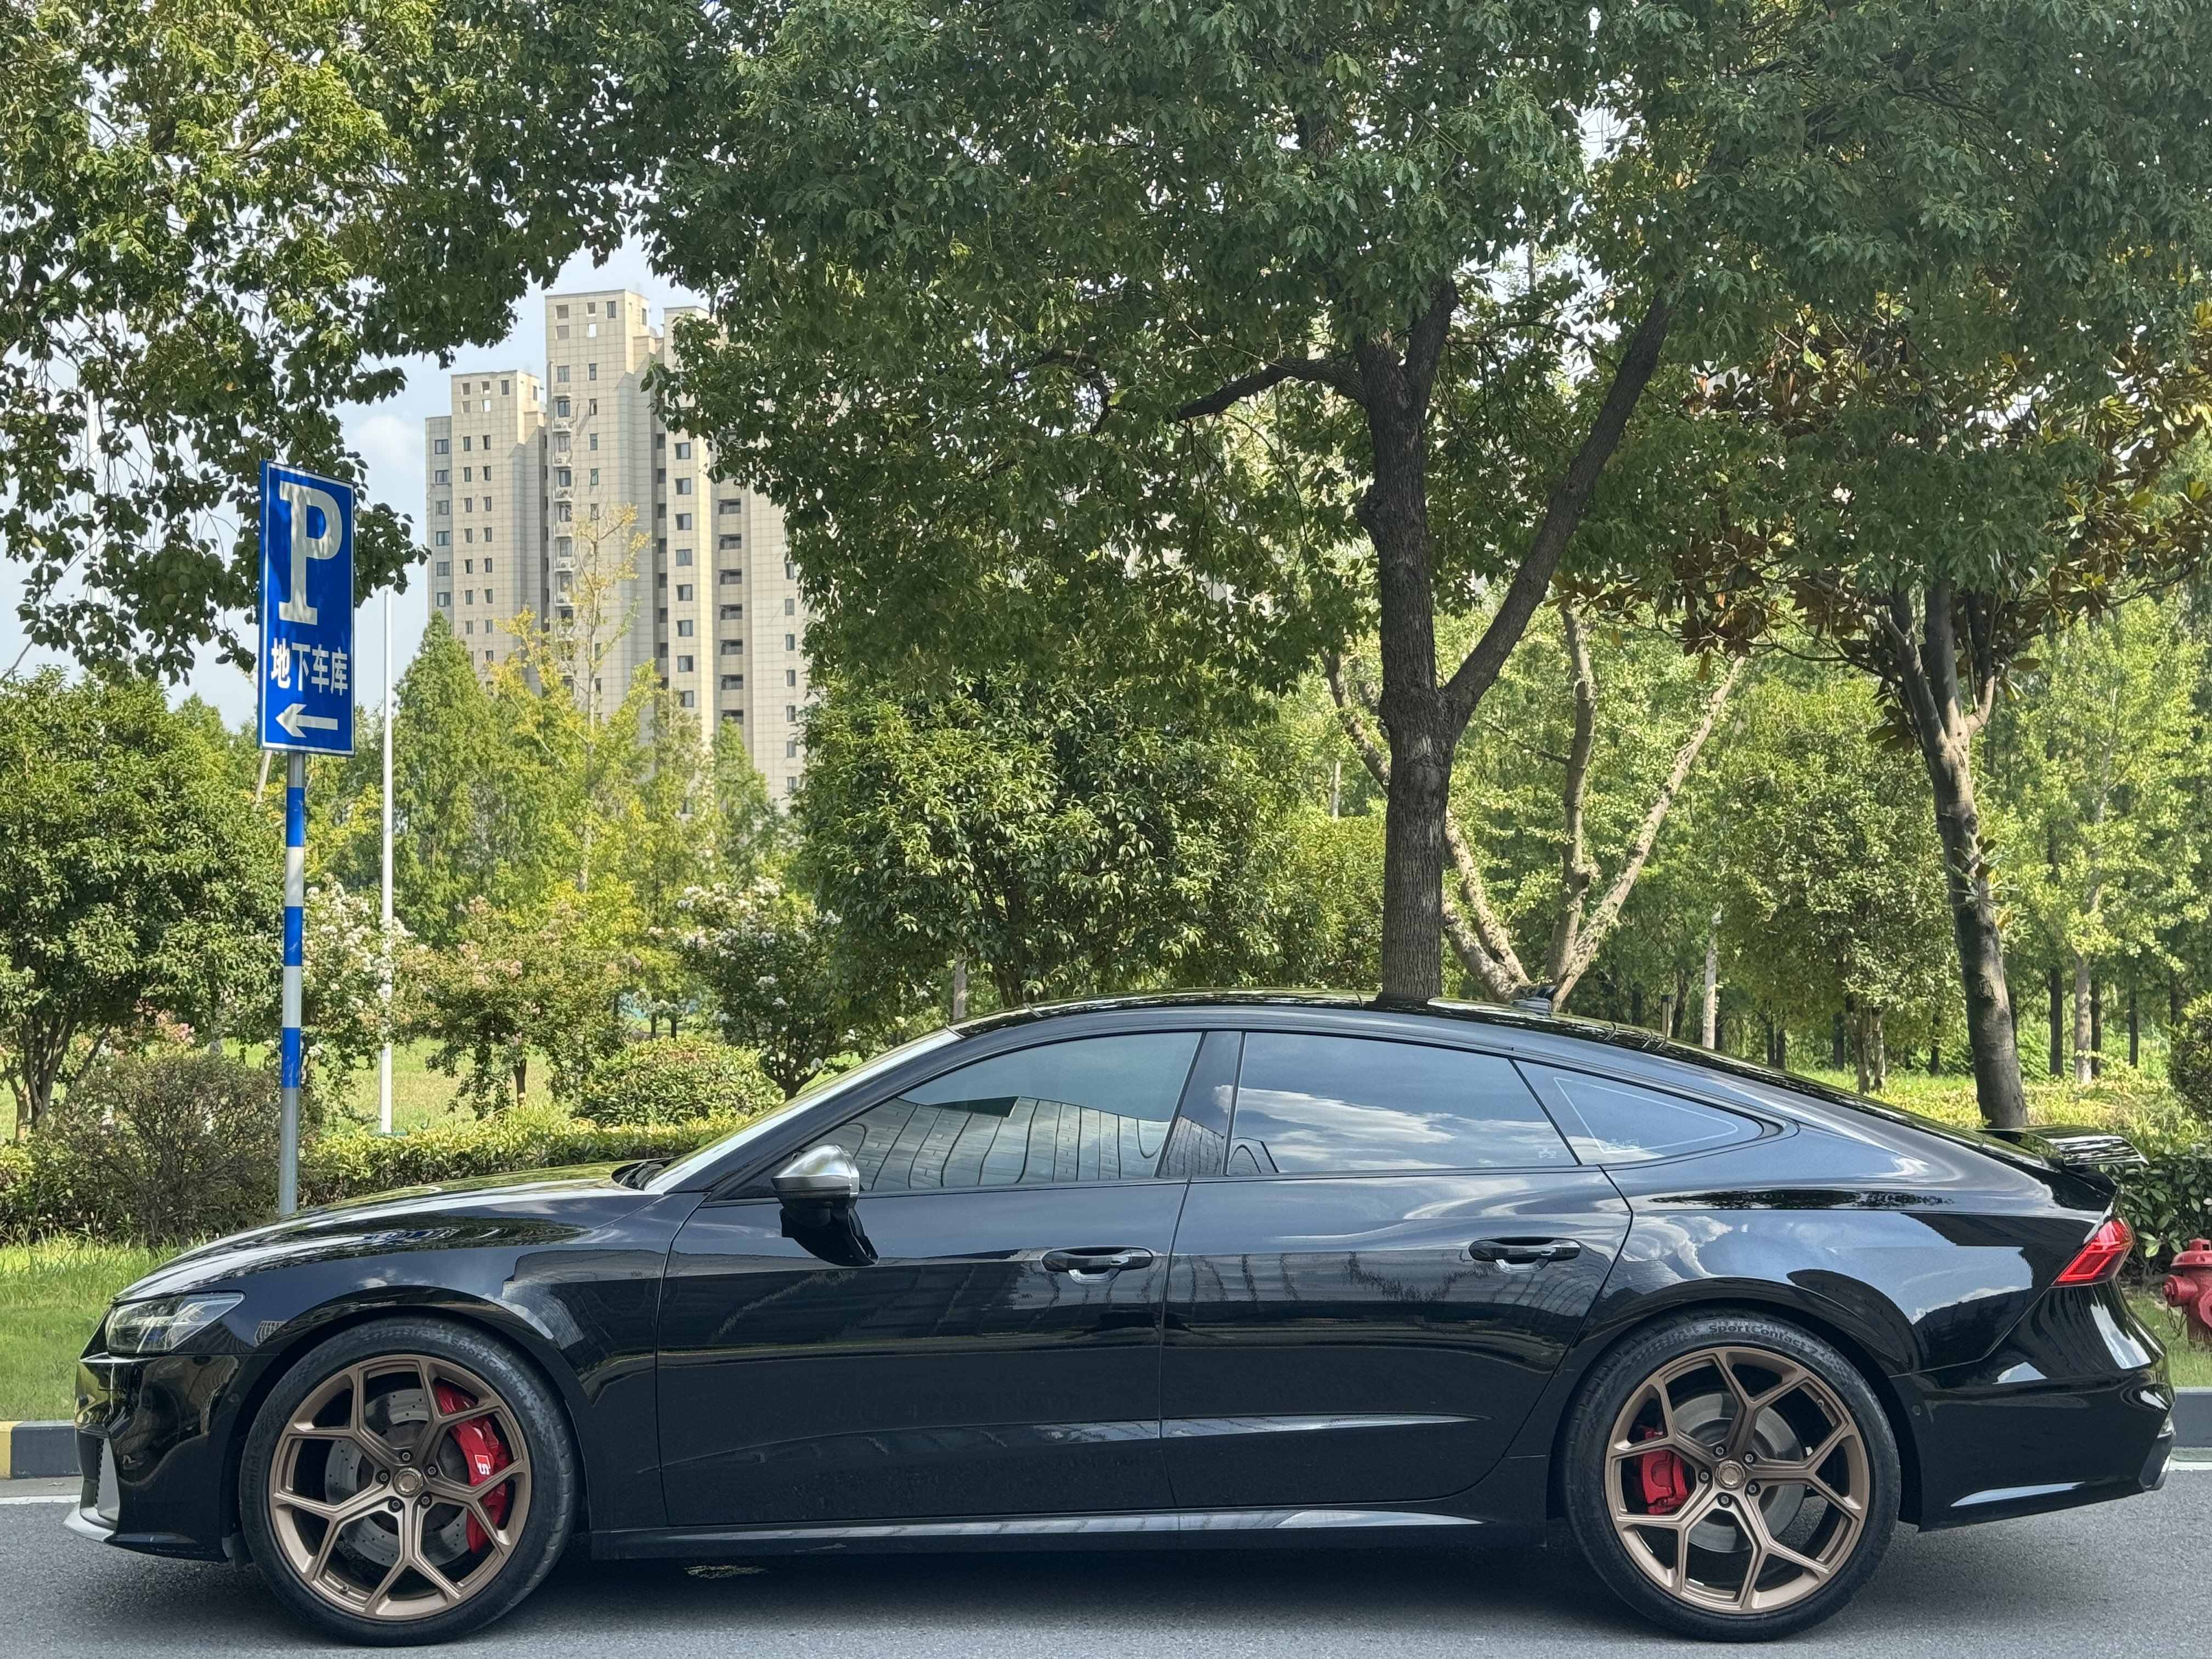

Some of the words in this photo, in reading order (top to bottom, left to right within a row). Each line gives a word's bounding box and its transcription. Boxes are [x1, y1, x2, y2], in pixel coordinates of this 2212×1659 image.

[279, 479, 342, 626] P
[271, 637, 348, 696] 地下车库
[1708, 1323, 1807, 1350] SportContact
